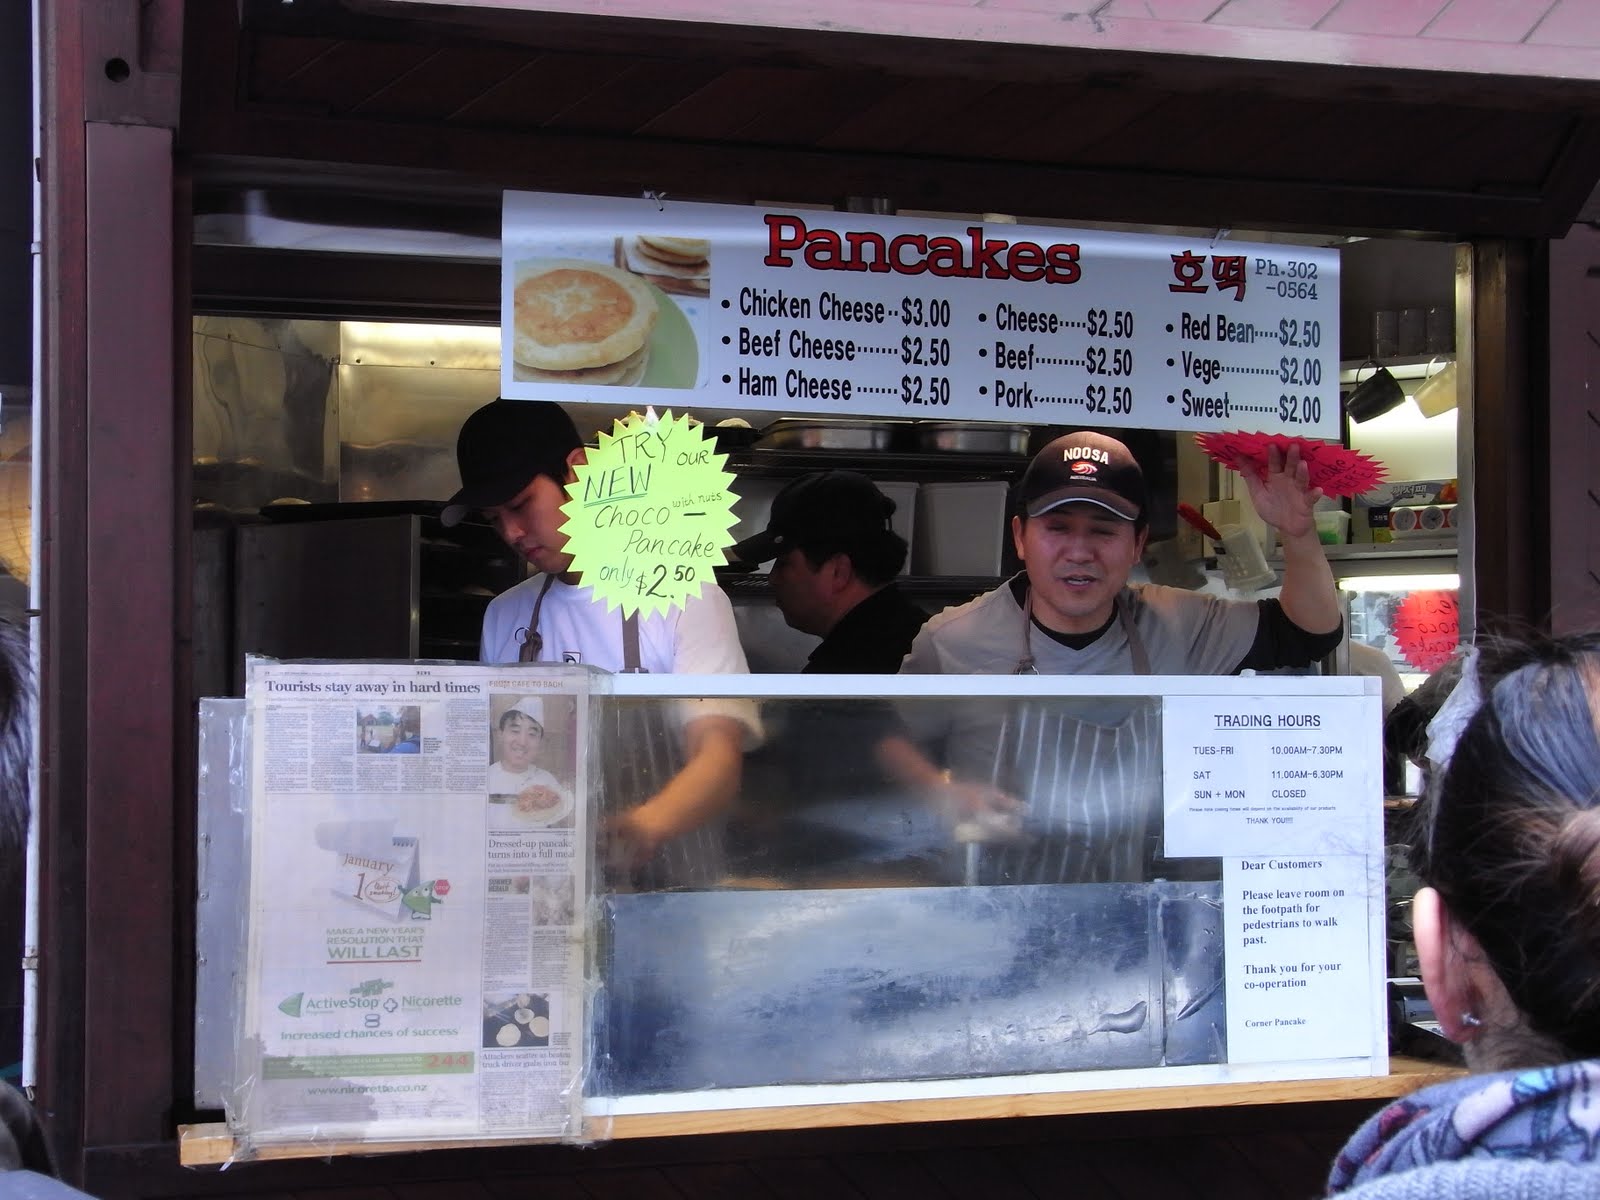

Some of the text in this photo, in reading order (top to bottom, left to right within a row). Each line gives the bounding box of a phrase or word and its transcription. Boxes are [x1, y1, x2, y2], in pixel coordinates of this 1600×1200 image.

[763, 213, 1081, 285] Pancakes
[1168, 249, 1247, 302] 호떡
[1255, 258, 1319, 281] Ph.302
[738, 286, 950, 328] Chicken Cheese $3.00
[996, 303, 1133, 339] Cheese $2.50
[1181, 312, 1321, 348] Red Bean $2.50
[739, 327, 950, 367] Beef Cheese $2.50
[995, 341, 1132, 376] Beef $2.50
[1182, 350, 1321, 386] Vege $2.00
[739, 367, 950, 406] Ham Cheese $2.50
[995, 380, 1132, 414] Pork $2.50
[1181, 388, 1321, 424] Sweet $2.00
[611, 428, 710, 466] TRY OUR
[1063, 447, 1109, 465] NOOSA
[584, 463, 652, 502] NEW
[672, 497, 695, 509] with
[698, 491, 723, 504] nuts
[623, 529, 715, 558] Pancake
[600, 556, 635, 589] only
[265, 680, 481, 695] Tourists stay away in hard times
[1214, 714, 1321, 727] TRADING HOURS
[1193, 746, 1342, 755] TUES-FRI 10.00AM~7.30PM
[1193, 770, 1344, 779] SAT 11.00AM~6.30PM
[1194, 791, 1212, 799] SUN
[1225, 790, 1245, 799] MON
[1271, 790, 1307, 798] CLOSED
[1246, 817, 1269, 825] THANK
[488, 839, 537, 849] Dressed-up
[488, 850, 510, 859] turns
[513, 849, 530, 859] into
[539, 849, 553, 858] full
[343, 853, 395, 876] January
[1241, 859, 1323, 871] Dear Customers
[1242, 889, 1345, 901] Please leave room on
[1242, 903, 1320, 917] the footpath for
[1243, 917, 1338, 932] pedestrians to walk
[326, 935, 423, 944] RESOLUTION THAT
[1243, 935, 1267, 947] past.
[327, 945, 423, 959] WILL LAST
[1244, 962, 1342, 976] Thank you for your
[1244, 978, 1307, 991] co-operation
[306, 995, 462, 1010] ActiveStop Nicorette
[1245, 1018, 1307, 1028] Corner Pancake
[281, 1027, 459, 1041] Increased chances of success
[307, 1084, 428, 1096] www.nicorette.co.nz
